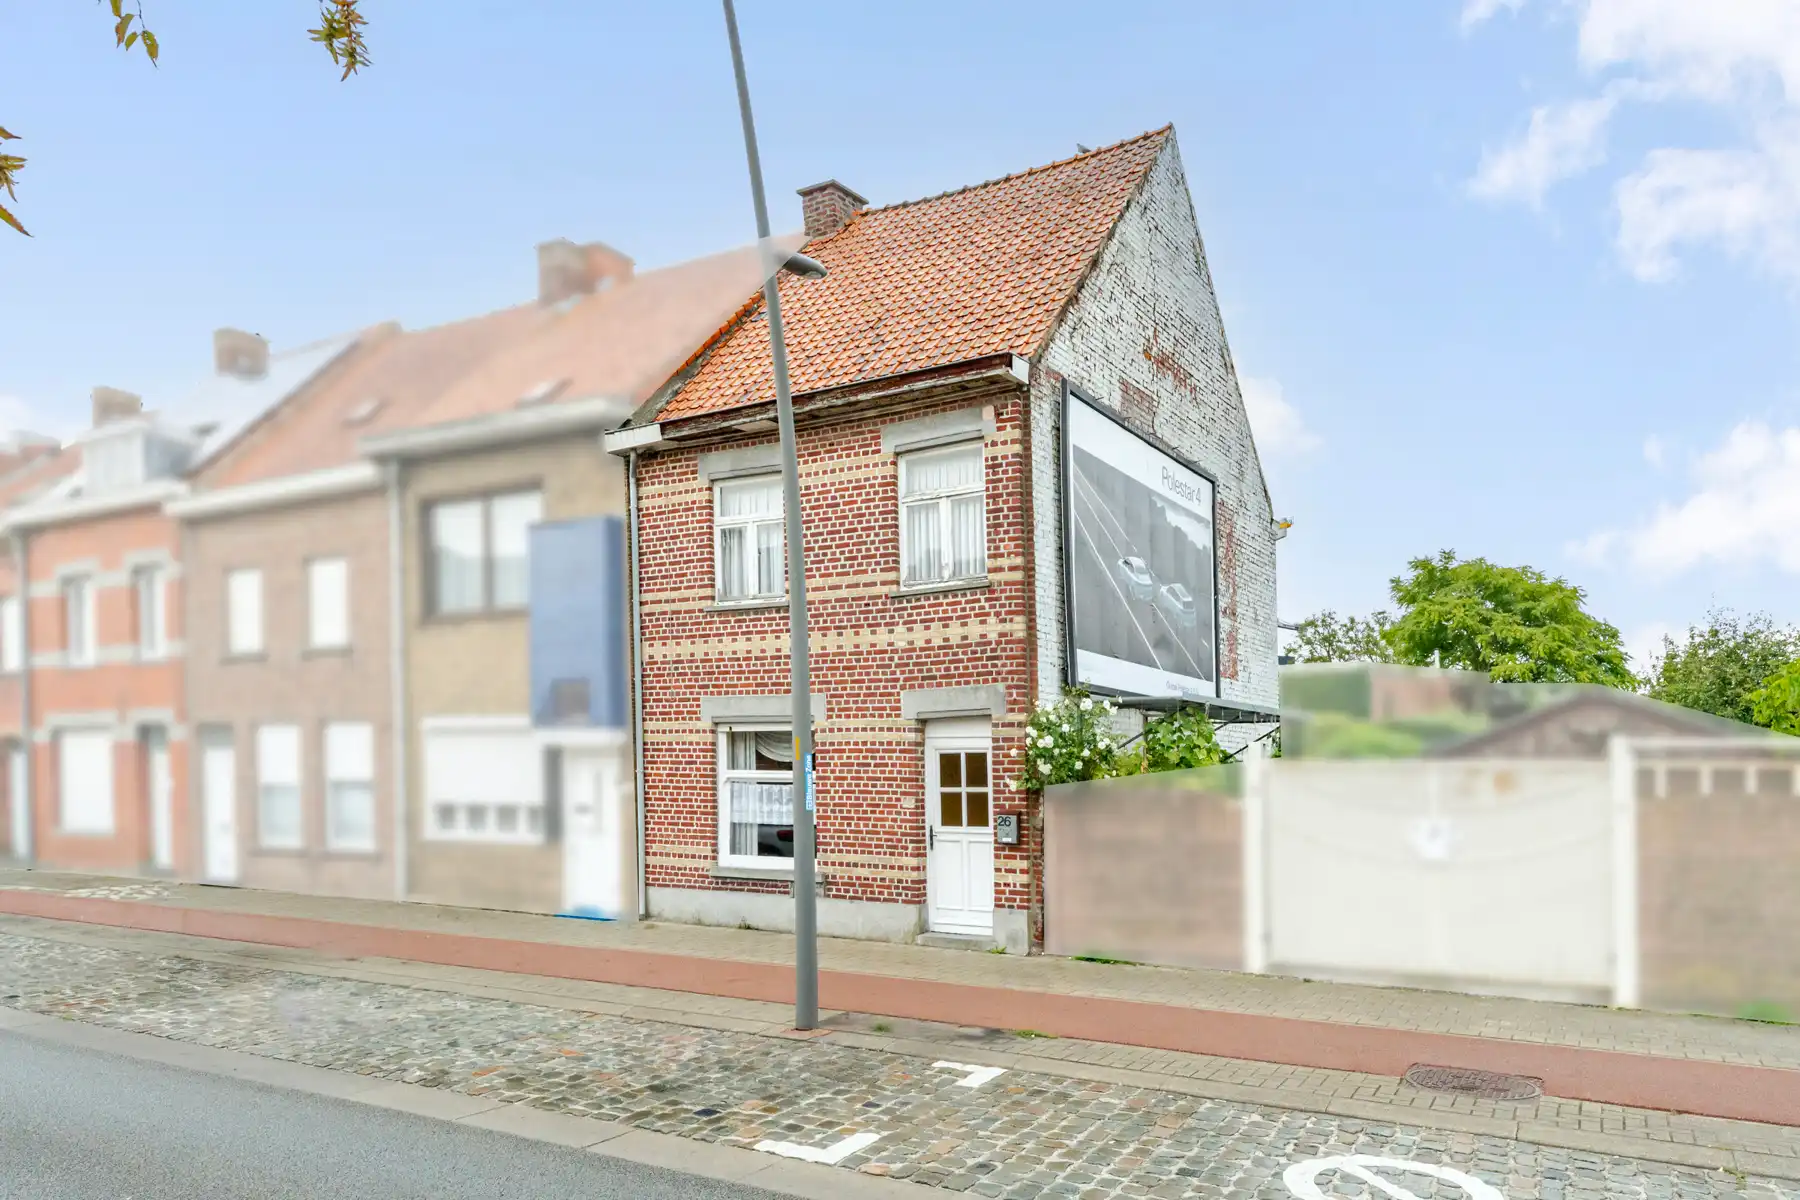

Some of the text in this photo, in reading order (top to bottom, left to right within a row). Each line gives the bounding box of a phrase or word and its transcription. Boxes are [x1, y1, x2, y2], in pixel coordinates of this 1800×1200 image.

[1162, 466, 1201, 505] Polestar 4
[998, 816, 1011, 827] 26
